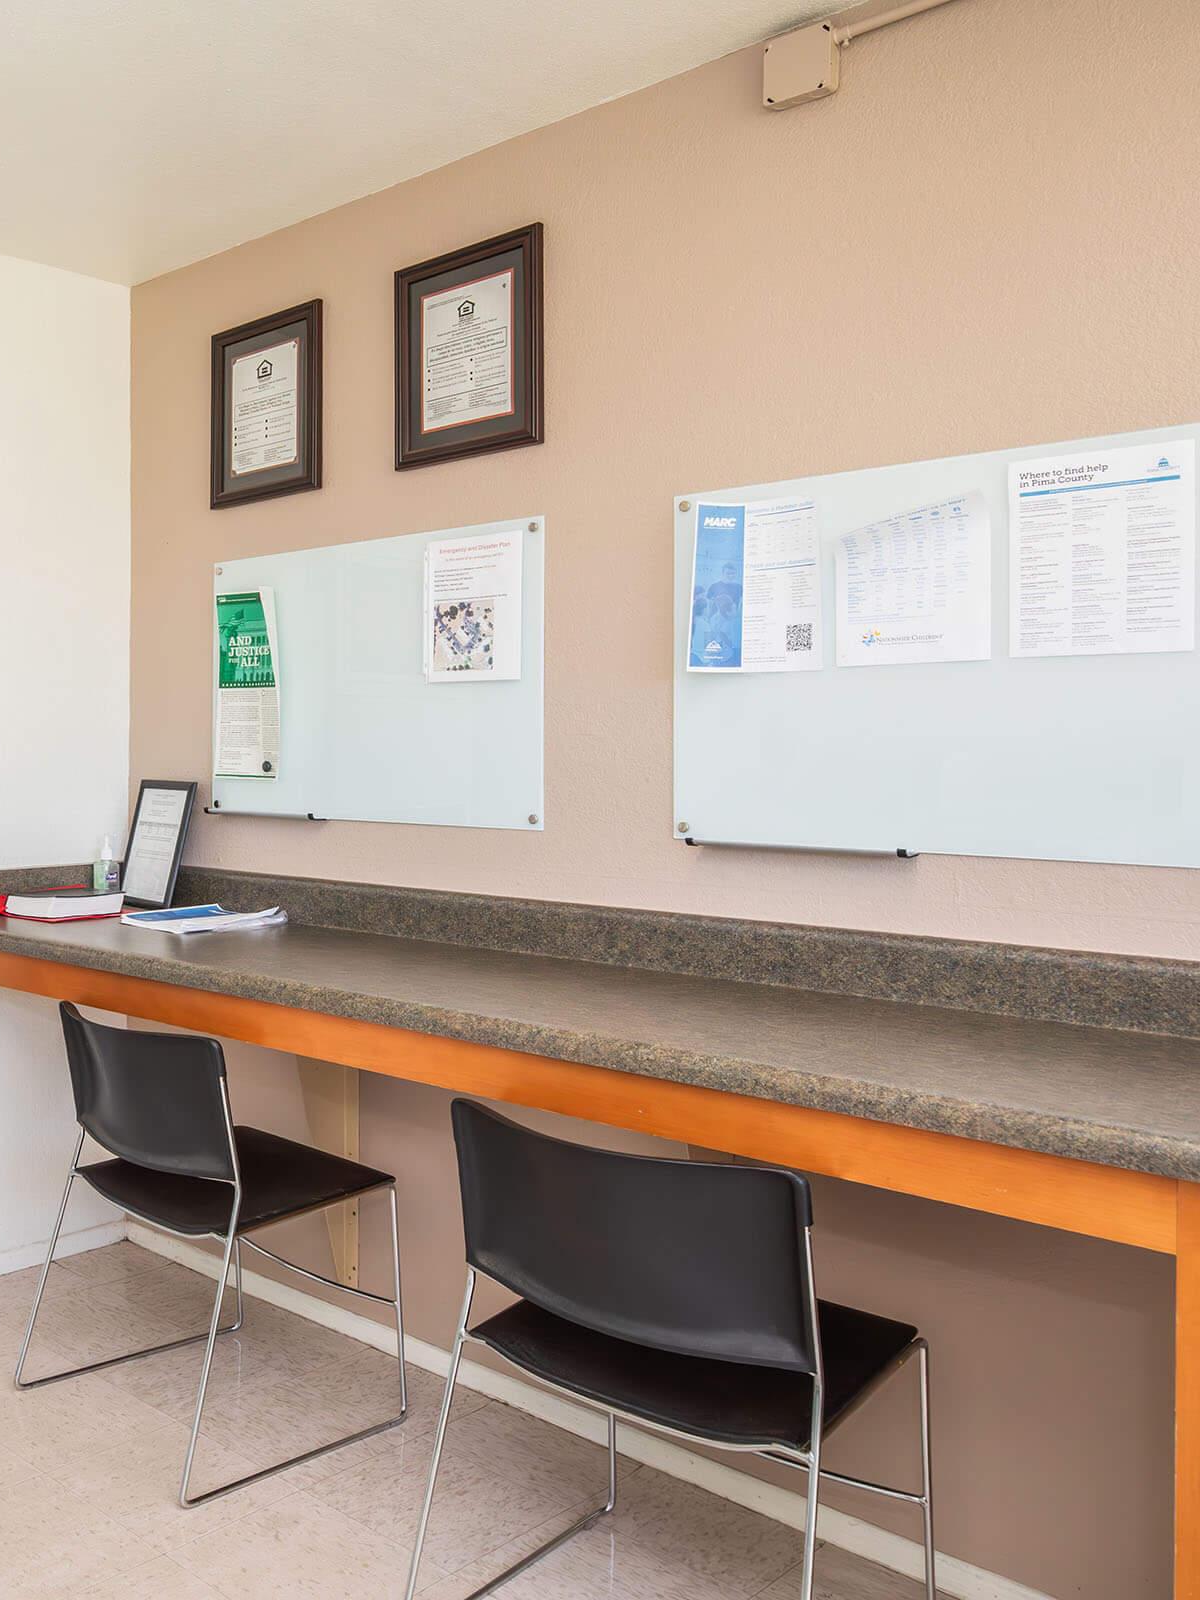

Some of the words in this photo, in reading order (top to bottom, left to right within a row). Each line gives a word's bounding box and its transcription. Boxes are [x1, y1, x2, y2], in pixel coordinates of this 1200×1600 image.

[1019, 471, 1051, 481] Where
[1052, 469, 1063, 477] to
[1064, 465, 1084, 476] find
[1086, 463, 1109, 473] help
[1019, 481, 1030, 489] in
[1031, 479, 1056, 487] Pima
[1057, 473, 1095, 484] County
[703, 516, 737, 528] MARC
[228, 635, 252, 647] AND
[228, 645, 271, 657] JUSTICE
[241, 656, 260, 667] ALL
